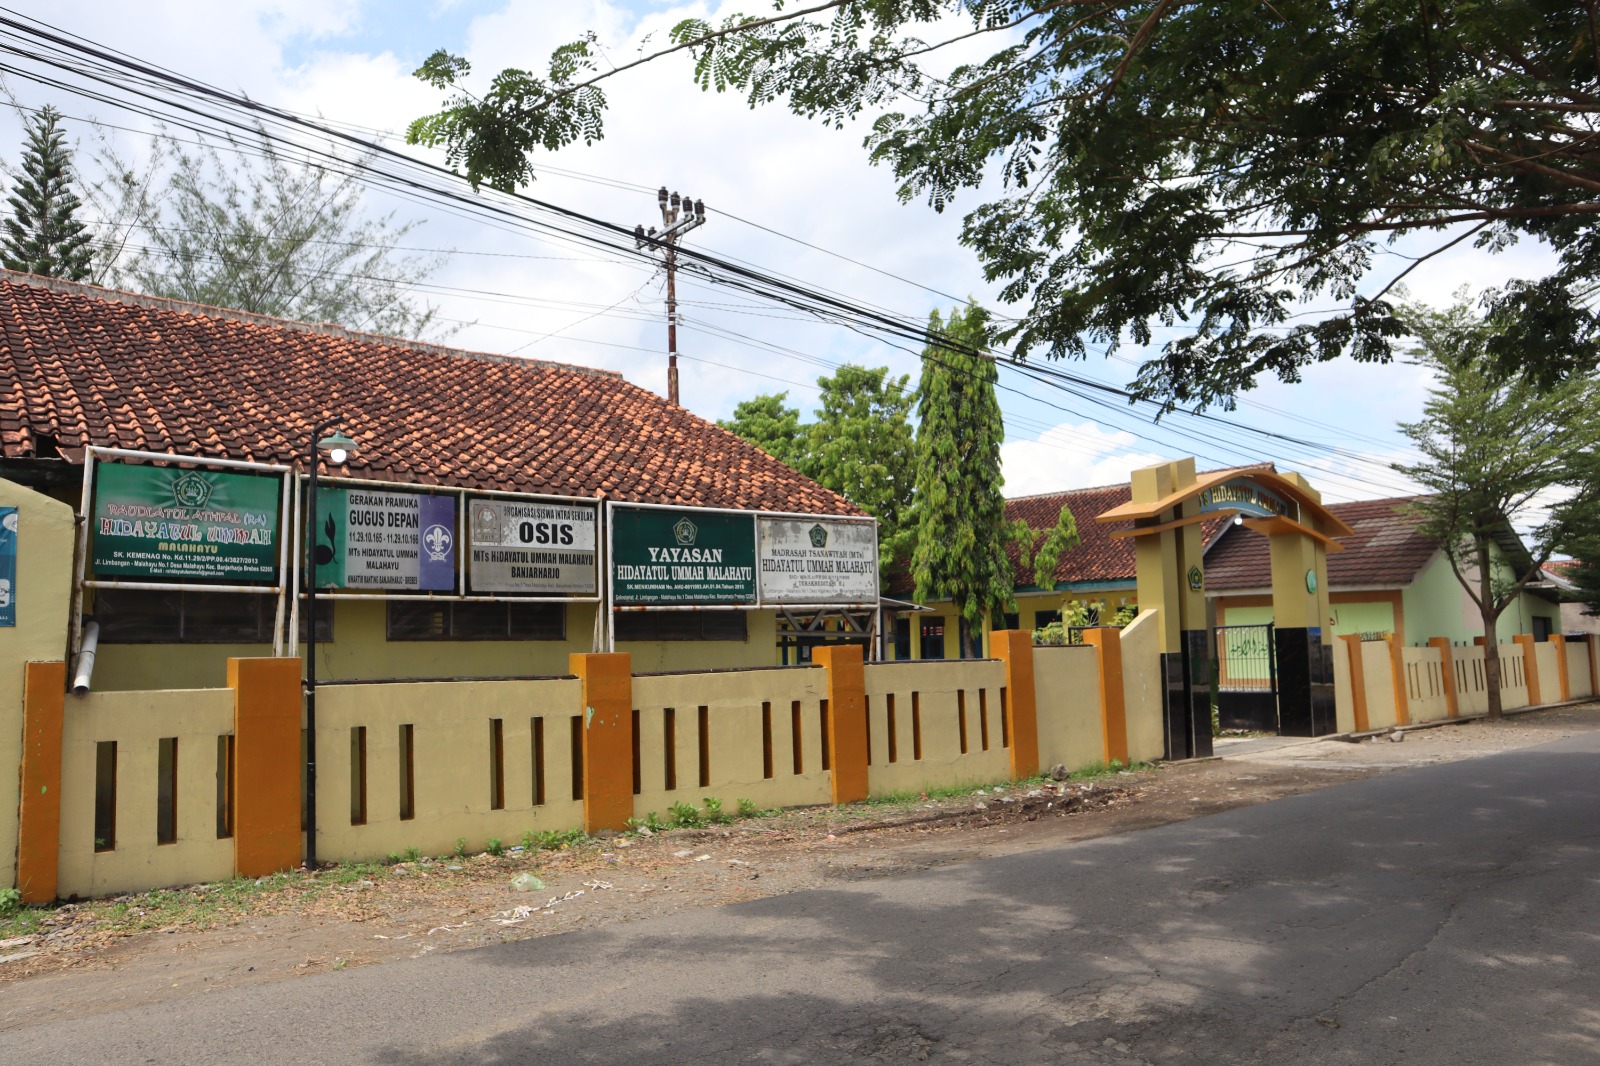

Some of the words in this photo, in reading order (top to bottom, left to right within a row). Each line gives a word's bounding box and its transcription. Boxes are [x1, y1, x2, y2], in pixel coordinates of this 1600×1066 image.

[349, 494, 383, 507] GERAKAN
[385, 496, 418, 508] PRAMUKA
[1210, 485, 1257, 505] HIDAYATUL
[108, 504, 190, 520] RAUDLATUL
[536, 508, 555, 519] SISWA
[349, 510, 385, 527] GUGUS
[387, 512, 419, 529] DEPAN
[100, 517, 202, 542] HIDAYATUL
[207, 525, 272, 545] UMMAH
[519, 521, 574, 545] OSIS
[158, 541, 218, 554] MALAHAYU
[348, 547, 361, 557] MTs
[361, 548, 395, 558] HIDAYATUL
[396, 549, 418, 559] UMMAH
[771, 548, 807, 557] MADRASAH
[808, 549, 847, 559] TSANAWIYAH
[126, 552, 160, 560] KEMENAG
[473, 550, 489, 562] MTs
[531, 552, 557, 564] UMMAH
[558, 553, 593, 566] MALAHAYU
[648, 547, 723, 563] YAYASAN
[102, 559, 130, 567] Limbangan
[134, 560, 158, 569] Malahayu
[183, 562, 205, 572] Malahayu
[216, 564, 243, 573] Banjarharjo
[366, 561, 399, 571] MALAHAYU
[511, 566, 560, 579] BANJARHARJO
[617, 565, 670, 580] HIDAYATUL
[671, 566, 704, 580] UMMAH
[706, 566, 752, 581] MALAHAYU
[762, 559, 805, 573] HIDAYATUL
[806, 560, 834, 573] UMMAH
[835, 560, 873, 574] MALAHAYU
